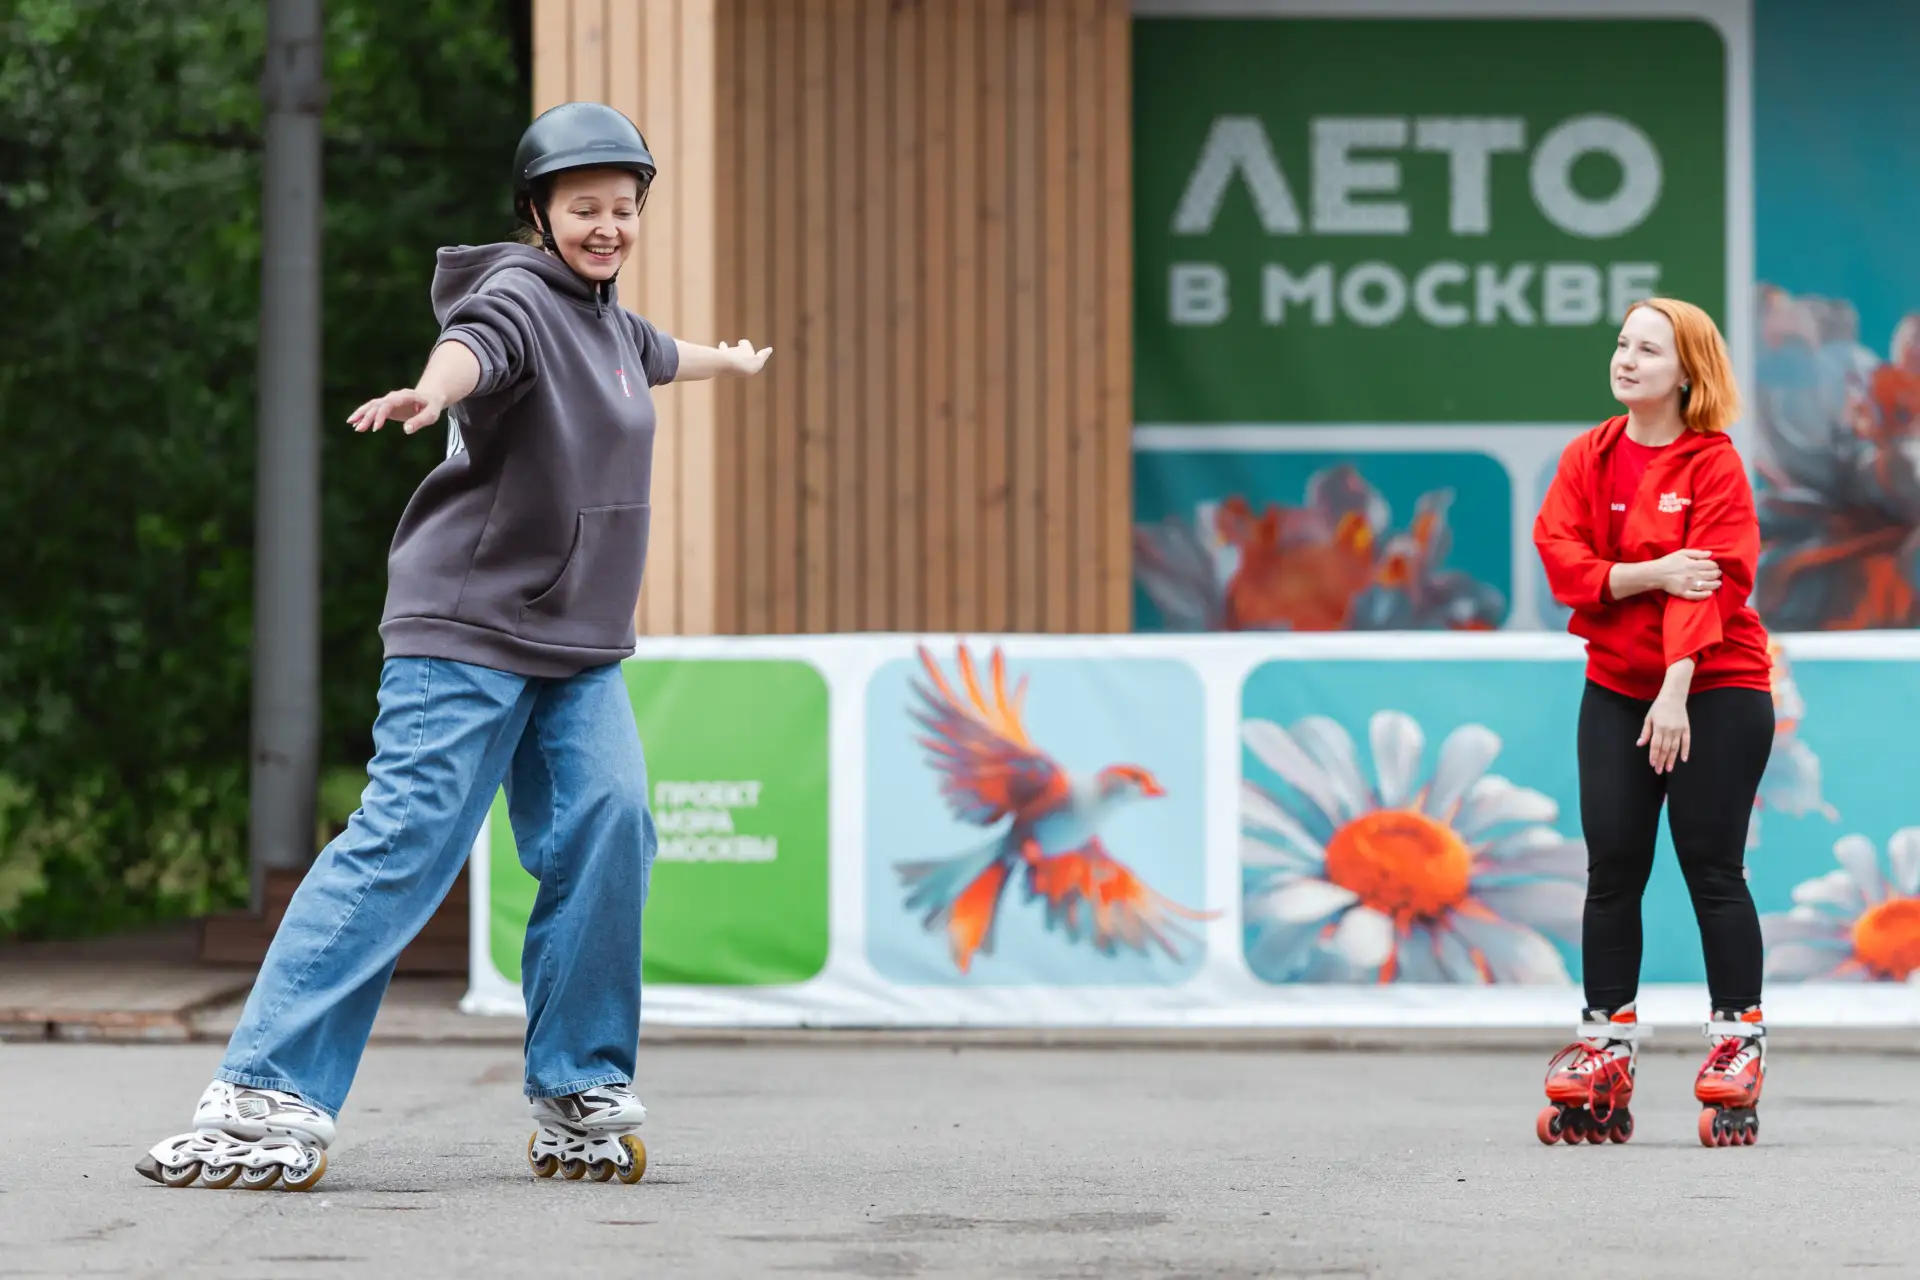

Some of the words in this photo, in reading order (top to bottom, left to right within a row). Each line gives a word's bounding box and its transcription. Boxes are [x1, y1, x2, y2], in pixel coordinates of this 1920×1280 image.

[1171, 114, 1663, 236] ЛЕТО
[1169, 263, 1229, 324] В
[1262, 262, 1661, 325] МОСКВЕ
[655, 780, 763, 808] ПРОЕКТ
